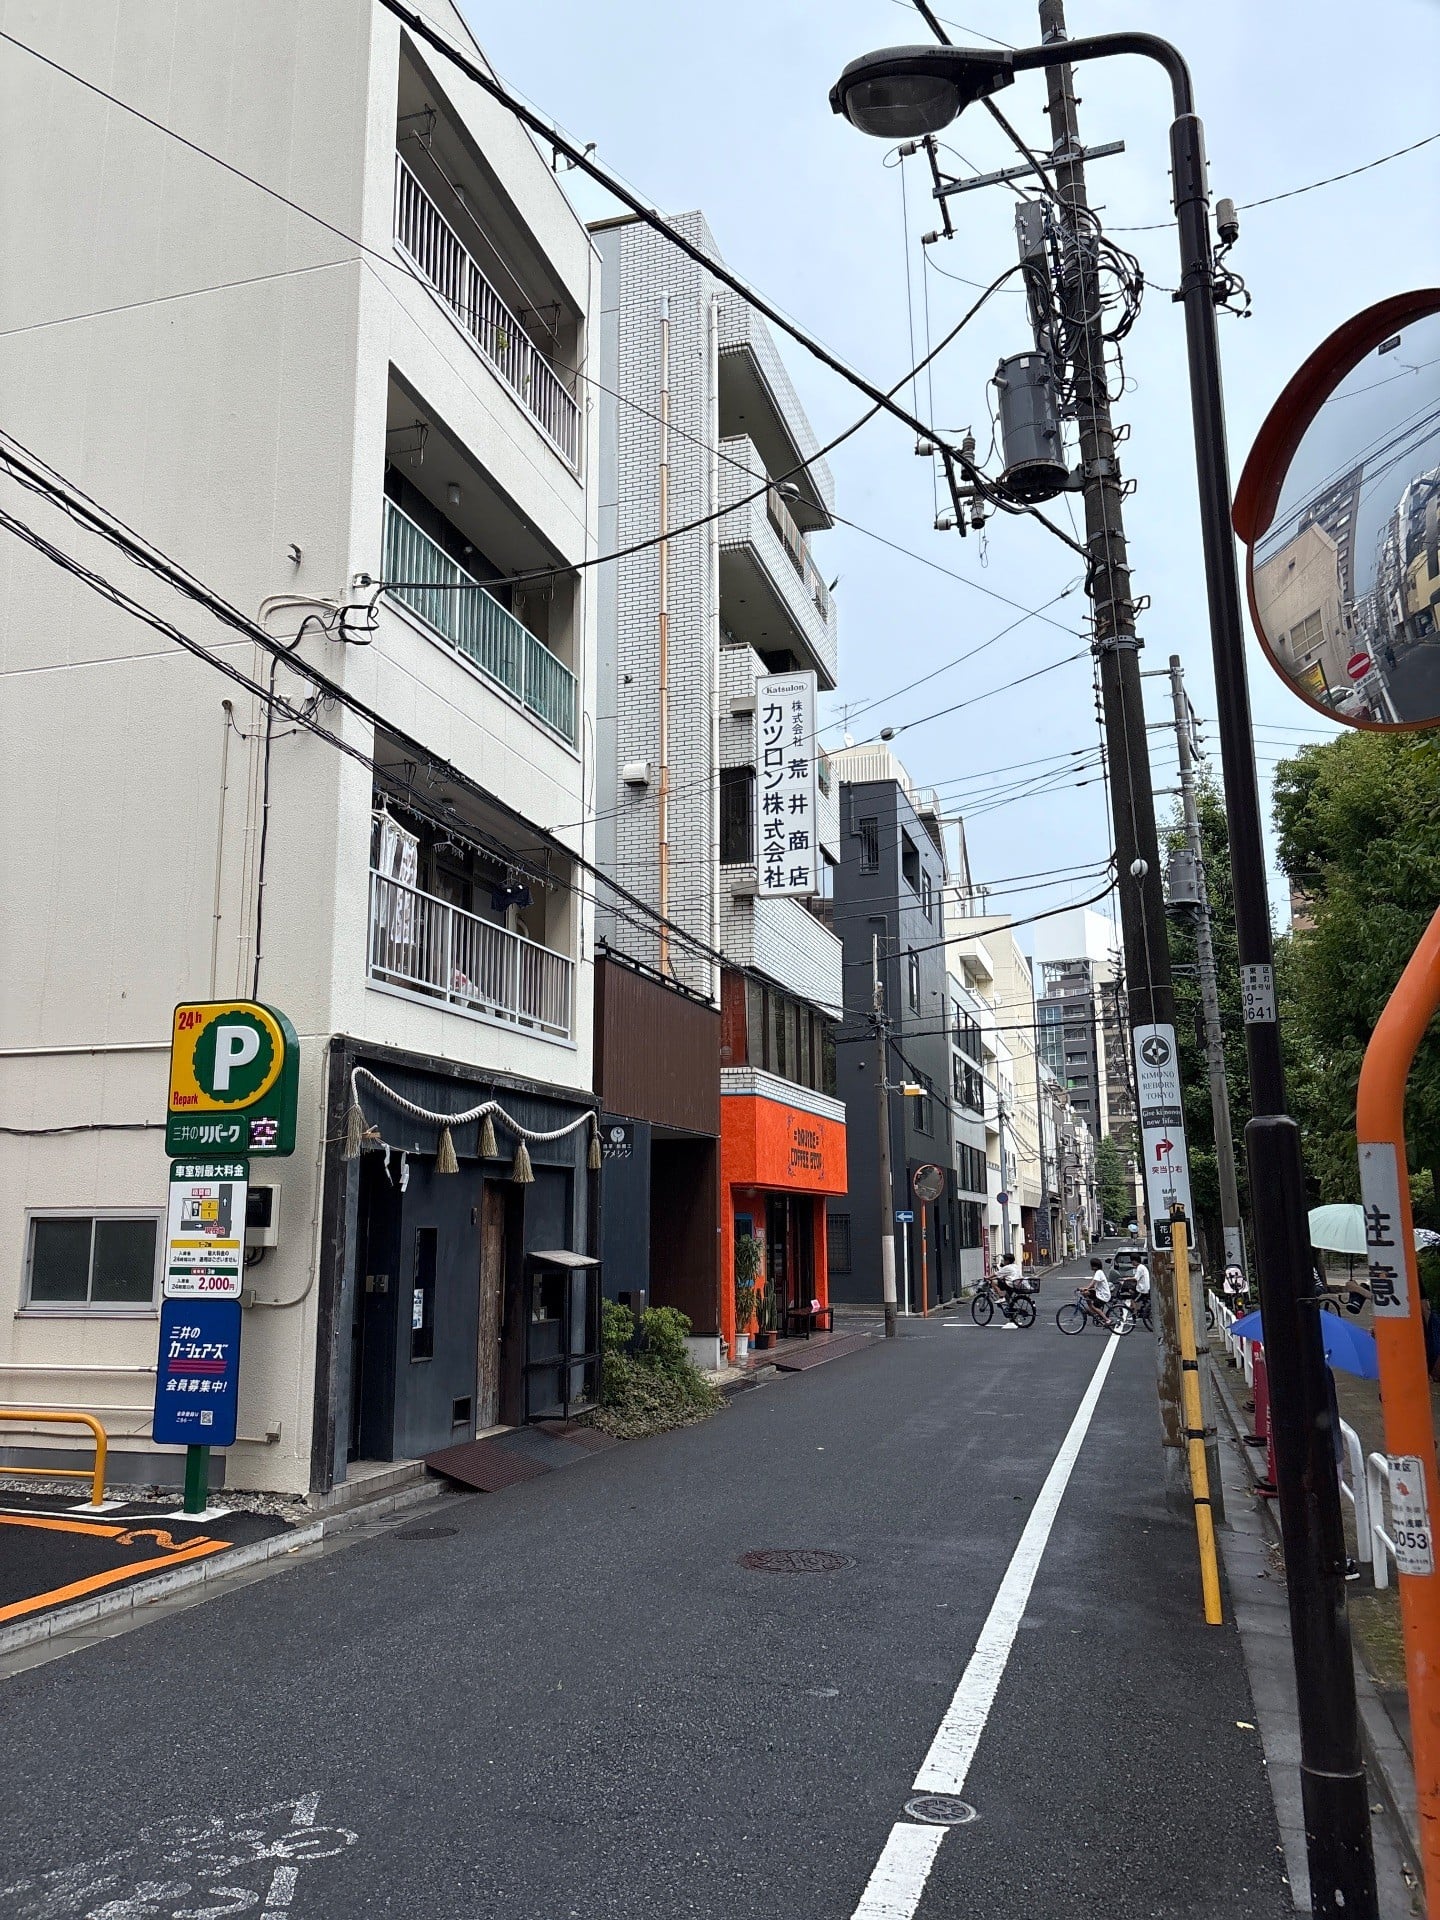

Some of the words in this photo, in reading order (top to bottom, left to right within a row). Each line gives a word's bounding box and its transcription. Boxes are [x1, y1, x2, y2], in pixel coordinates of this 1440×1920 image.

[766, 684, 804, 694] Katsulon
[791, 700, 804, 747] 株式会社
[762, 703, 786, 888] カツロン株式会社
[787, 758, 810, 887] 荒井商店
[178, 1011, 202, 1031] 24h
[213, 1025, 260, 1091] P
[1141, 1071, 1175, 1080] KIMONO
[1143, 1082, 1175, 1091] REBORN
[173, 1091, 198, 1105] Repark
[1146, 1091, 1174, 1100] TOKYO
[173, 1124, 240, 1143] 三井のリパーク
[249, 1117, 277, 1149] 空
[791, 1147, 809, 1169] COFFEE
[175, 1164, 244, 1178] 車室別最大料金
[1151, 1165, 1183, 1174] 突当り右
[198, 1277, 235, 1291] 2,000円
[169, 1326, 201, 1339] 三井の
[168, 1341, 229, 1359] カーシェアーズ
[165, 1379, 228, 1393] 会員募集中!
